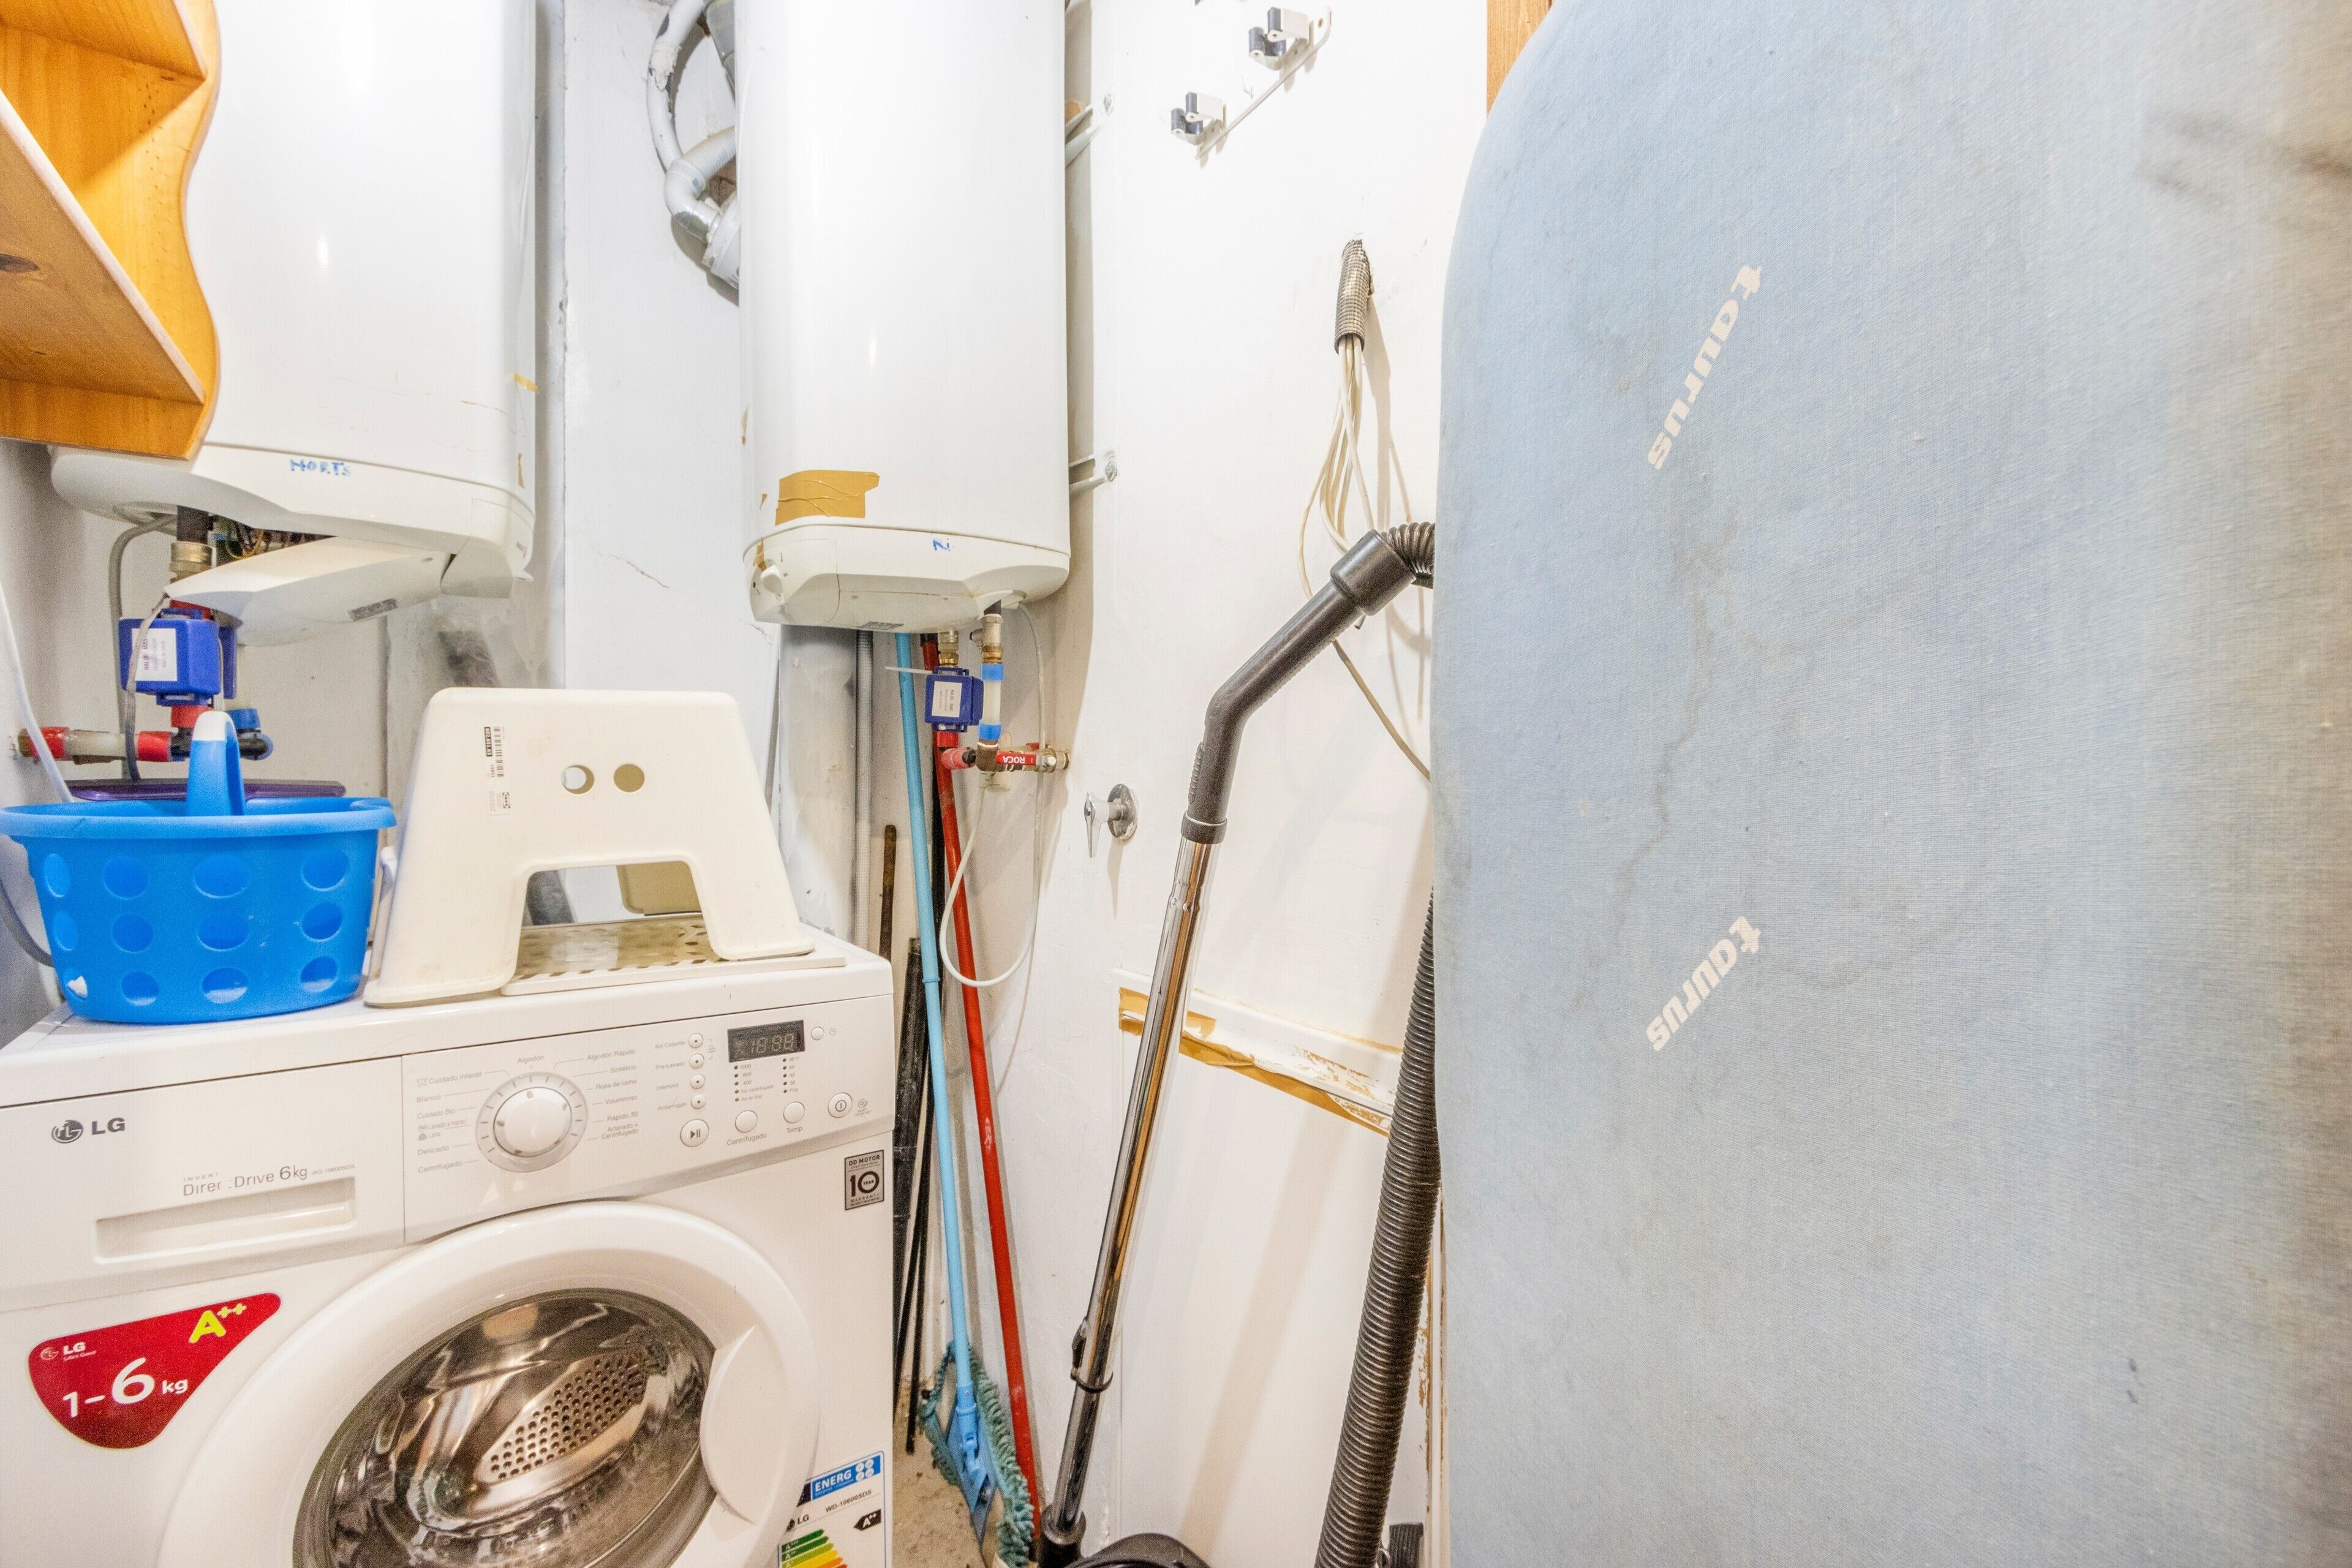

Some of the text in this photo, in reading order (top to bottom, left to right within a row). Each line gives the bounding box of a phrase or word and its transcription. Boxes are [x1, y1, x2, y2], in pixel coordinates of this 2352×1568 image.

[1647, 265, 1762, 470] taurus
[1646, 916, 1762, 1051] taurus
[518, 1055, 545, 1065] Algodón
[587, 1052, 612, 1061] Algodón
[610, 1065, 636, 1073] Sintético
[429, 1072, 482, 1085] Cuidado infantil
[417, 1094, 441, 1103] Blanco
[605, 1095, 638, 1105] Voluminoso
[417, 1110, 443, 1120] Cuidado
[92, 1117, 125, 1135] LG
[607, 1123, 633, 1132] Aclarado
[601, 1128, 638, 1139] Centrifugado
[727, 1133, 767, 1145] Centrifugado
[418, 1145, 450, 1156] Delicado
[859, 1155, 880, 1164] MOTOR
[418, 1161, 462, 1173] Centrifugado
[235, 1172, 274, 1188] Drive
[850, 1170, 880, 1197] 10
[189, 1303, 247, 1344] A++
[63, 1341, 86, 1355] LG
[162, 1377, 189, 1395] kg
[815, 1469, 852, 1492] ENERG
[797, 1489, 872, 1525] LG WD-10600SDS
[862, 1513, 877, 1528] A++
